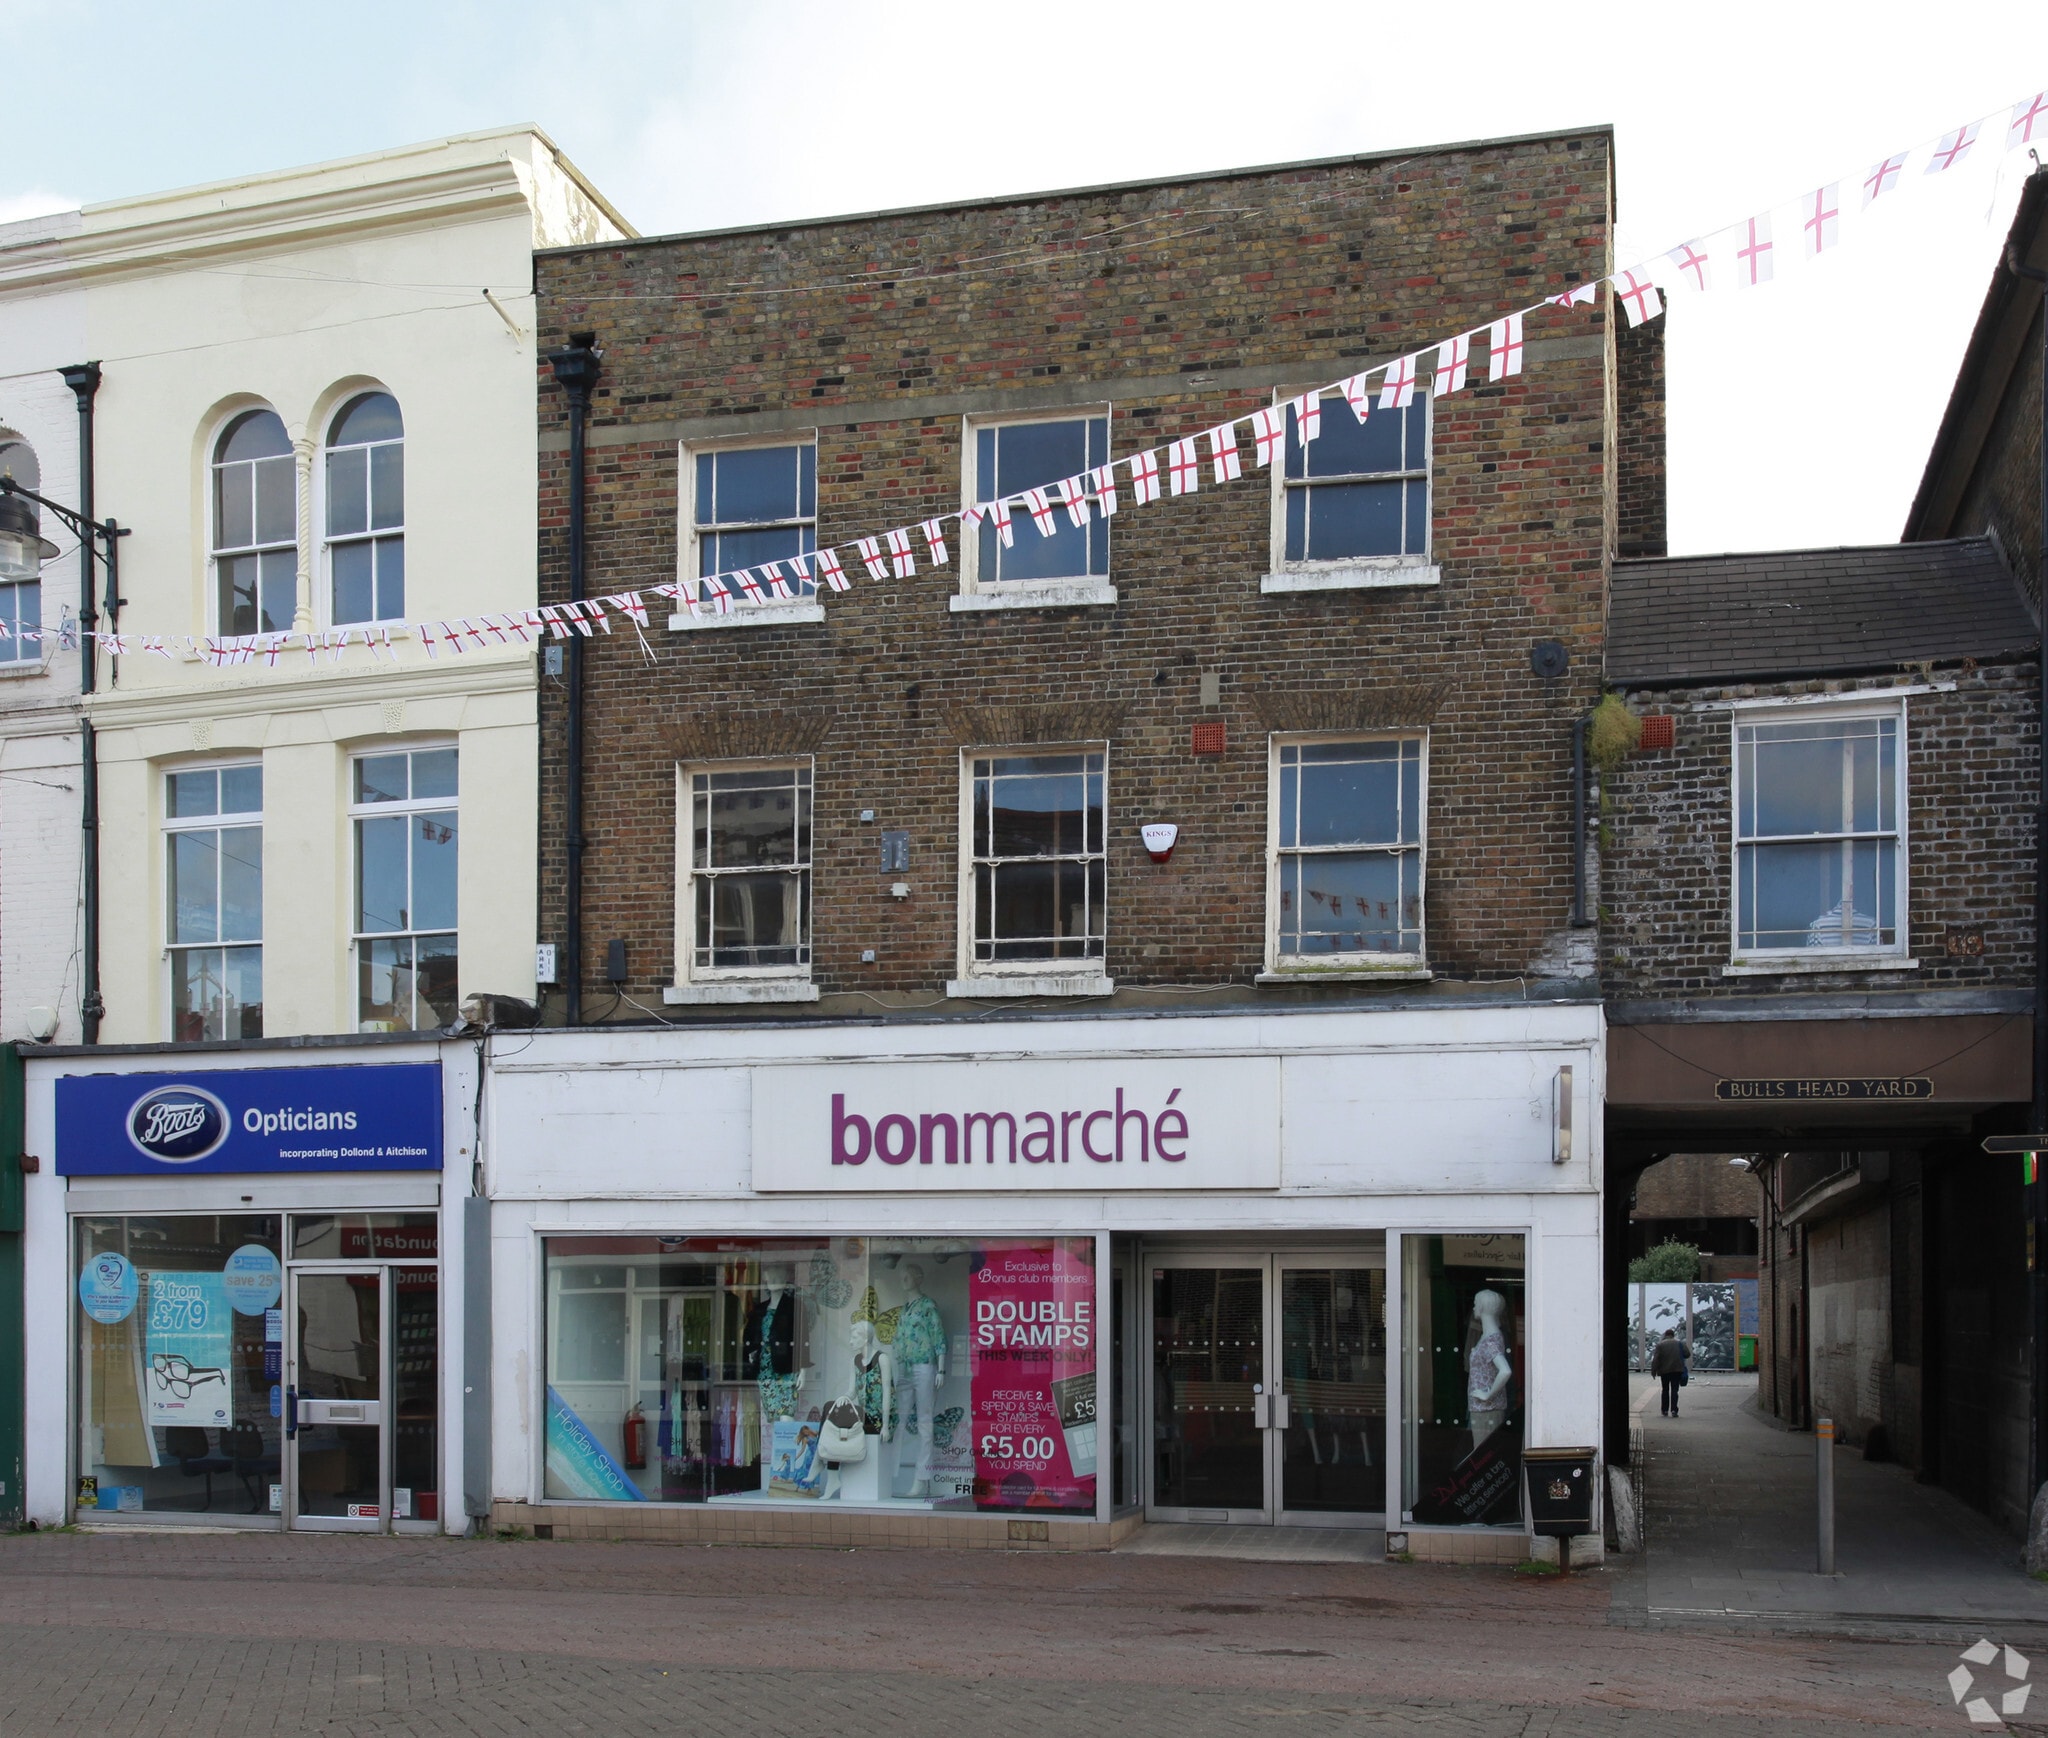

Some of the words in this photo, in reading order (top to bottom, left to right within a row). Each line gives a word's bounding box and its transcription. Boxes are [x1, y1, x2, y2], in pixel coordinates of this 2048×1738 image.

[1730, 1082, 1785, 1098] BULLS
[1797, 1082, 1850, 1097] HEAD
[1862, 1081, 1918, 1096] YARD
[140, 1103, 206, 1143] Boots
[243, 1107, 358, 1136] Opticians
[831, 1087, 1191, 1166] bonmarché
[279, 1148, 339, 1159] incorporating
[340, 1147, 375, 1157] Dollond
[377, 1148, 384, 1156] &
[386, 1146, 428, 1156] Aitchison
[1004, 1261, 1050, 1272] Exclusive
[1053, 1261, 1063, 1272] to
[226, 1275, 255, 1287] save
[977, 1268, 1017, 1284] Bonus
[1018, 1273, 1040, 1284] club
[1041, 1274, 1088, 1284] members
[153, 1280, 166, 1299] 2
[168, 1281, 202, 1299] from
[152, 1298, 208, 1330] £79
[976, 1300, 1091, 1323] DOUBLE
[977, 1323, 1089, 1347] STAMPS
[976, 1350, 1007, 1361] THIS
[1011, 1350, 1049, 1361] WEEK
[1053, 1350, 1091, 1362] ONLY!
[992, 1390, 1034, 1401] RECEIVE
[1036, 1391, 1043, 1400] 2
[981, 1401, 1017, 1411] SPEND
[1018, 1402, 1026, 1411] &
[1028, 1402, 1055, 1412] SAVE
[996, 1412, 1039, 1423] STAMPS
[555, 1408, 596, 1457] Holiday
[990, 1423, 1012, 1433] FOR
[1013, 1424, 1046, 1434] EVERY
[942, 1446, 967, 1457] SHOP
[980, 1435, 1055, 1460] £5.00
[566, 1443, 588, 1468] store
[587, 1467, 606, 1489] now
[593, 1454, 625, 1492] Shop
[989, 1460, 1011, 1470] YOU
[1013, 1461, 1047, 1471] SPEND
[81, 1478, 95, 1490] 25
[933, 1474, 963, 1484] Collect
[1454, 1493, 1471, 1507] We
[1469, 1479, 1486, 1496] offer
[1485, 1472, 1493, 1480] a
[1490, 1460, 1505, 1478] bra
[955, 1484, 988, 1496] FREE
[1463, 1494, 1486, 1517] fitting
[1483, 1466, 1512, 1498] service?
